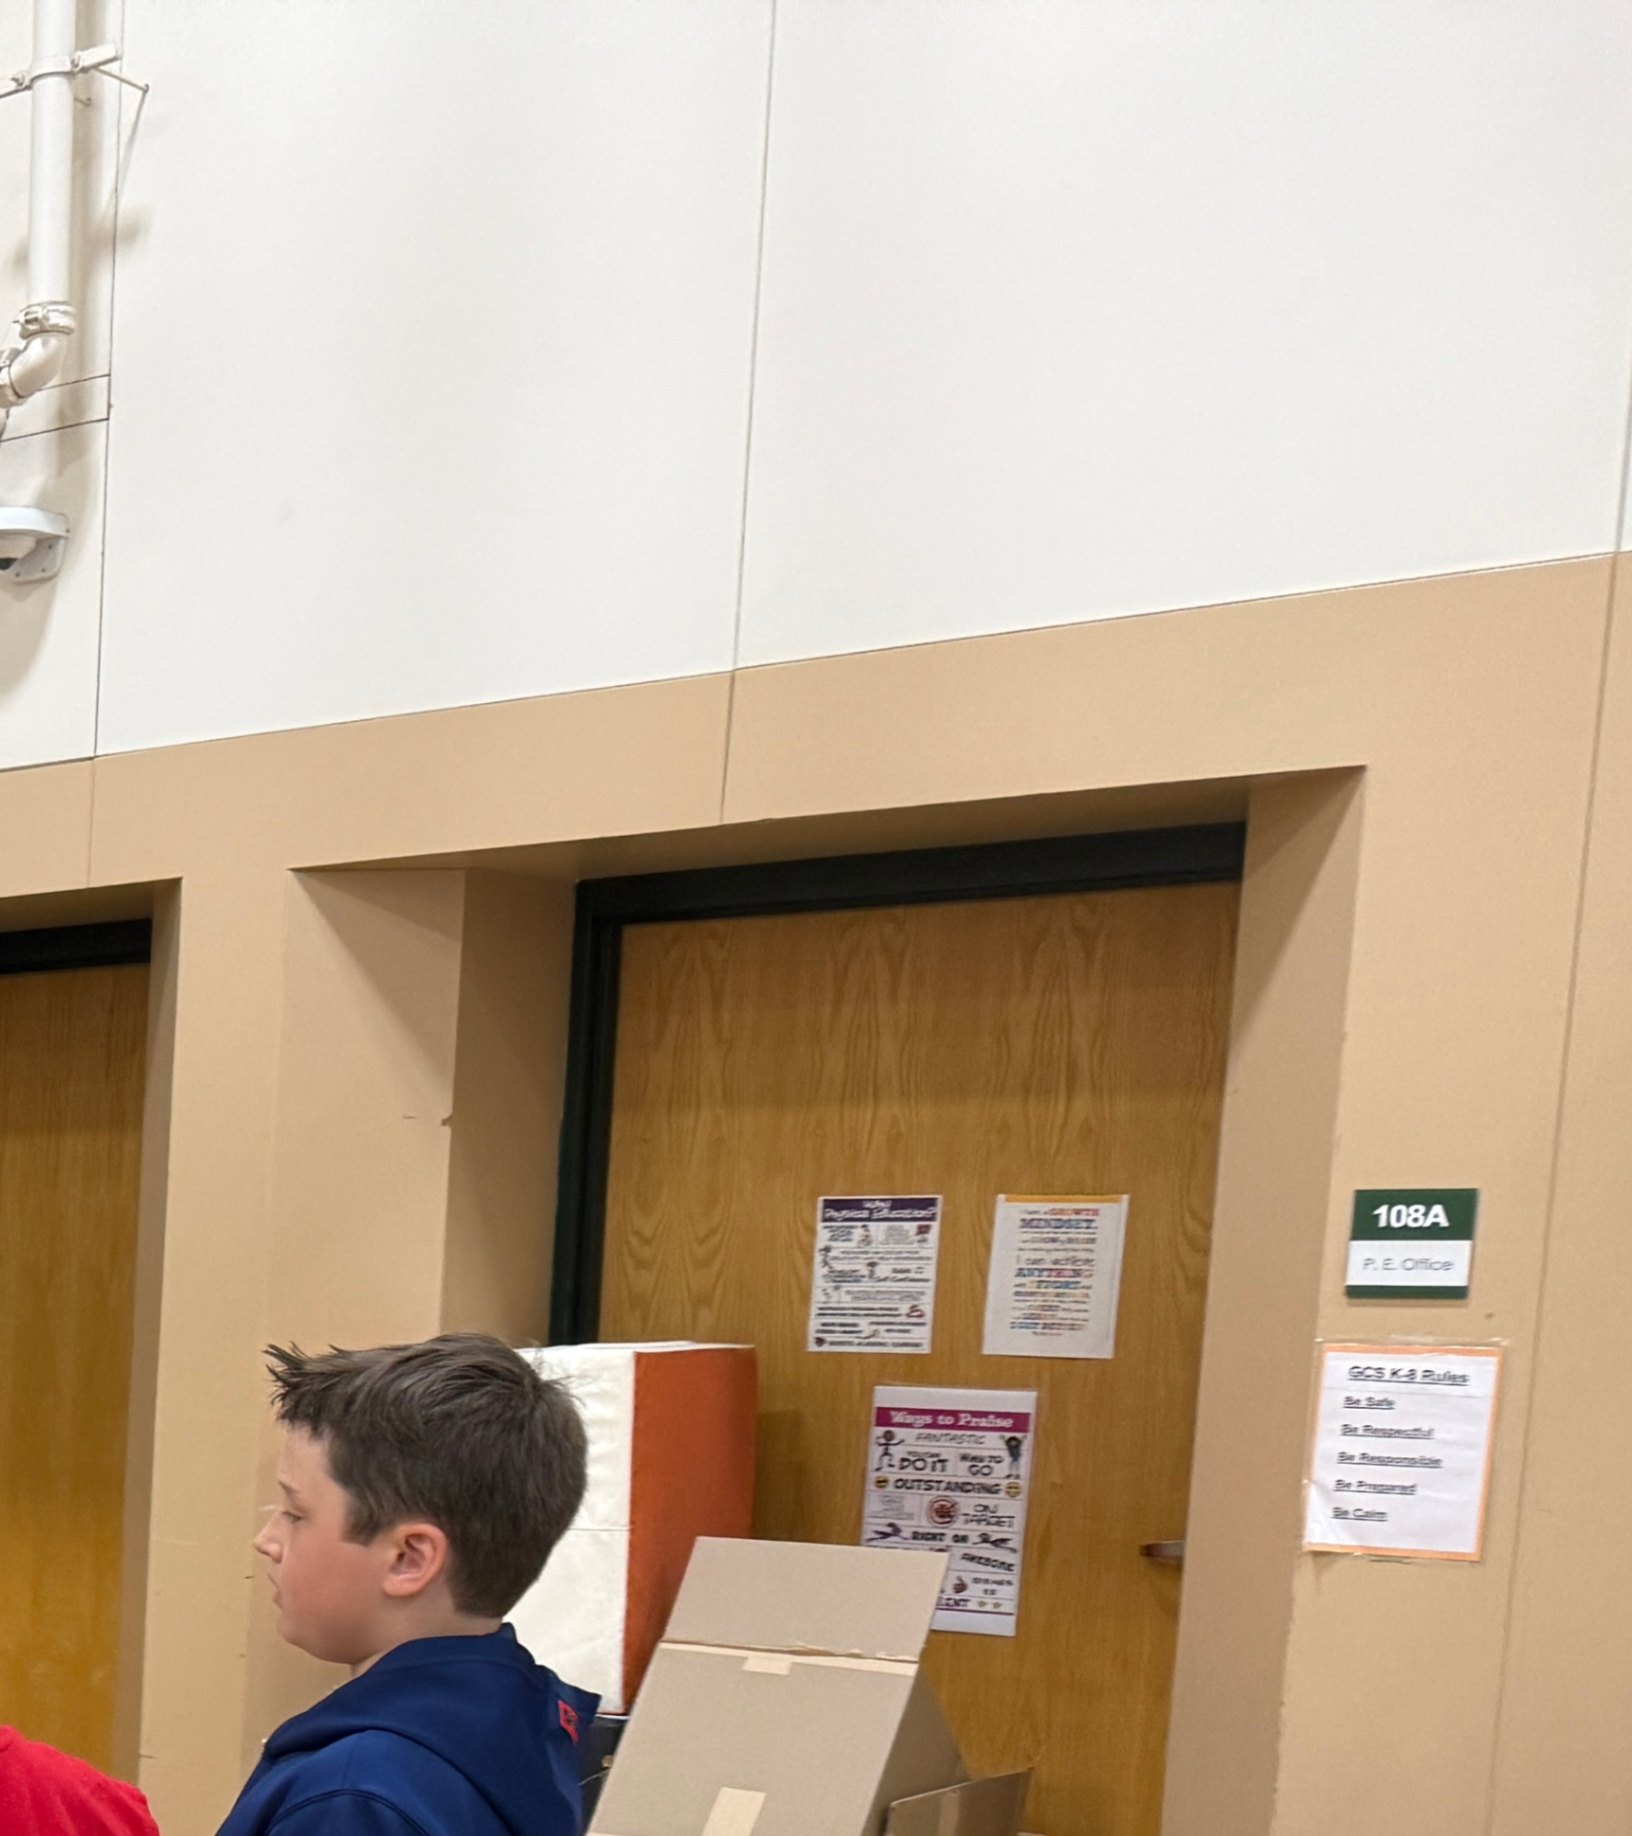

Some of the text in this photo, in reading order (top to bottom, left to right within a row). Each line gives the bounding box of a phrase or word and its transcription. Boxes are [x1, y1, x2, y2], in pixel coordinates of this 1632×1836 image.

[1373, 1203, 1450, 1228] 108A
[1401, 1257, 1454, 1271] Office
[1348, 1366, 1386, 1379] GCS
[1421, 1369, 1471, 1383] Rules
[1343, 1396, 1396, 1407] Be Safe
[890, 1410, 1014, 1428] Ways to Praise
[1341, 1423, 1435, 1438] Be Respectful
[915, 1432, 986, 1445] FANTASTIC
[899, 1457, 949, 1472] DO IT
[1337, 1451, 1443, 1466] Be Responsible
[968, 1464, 993, 1476] GO
[894, 1478, 1002, 1495] OUTSTANDING
[1335, 1479, 1352, 1489] Be
[974, 1503, 999, 1515] ON
[1332, 1506, 1389, 1519] Be Calm
[961, 1512, 1016, 1528] TARGET
